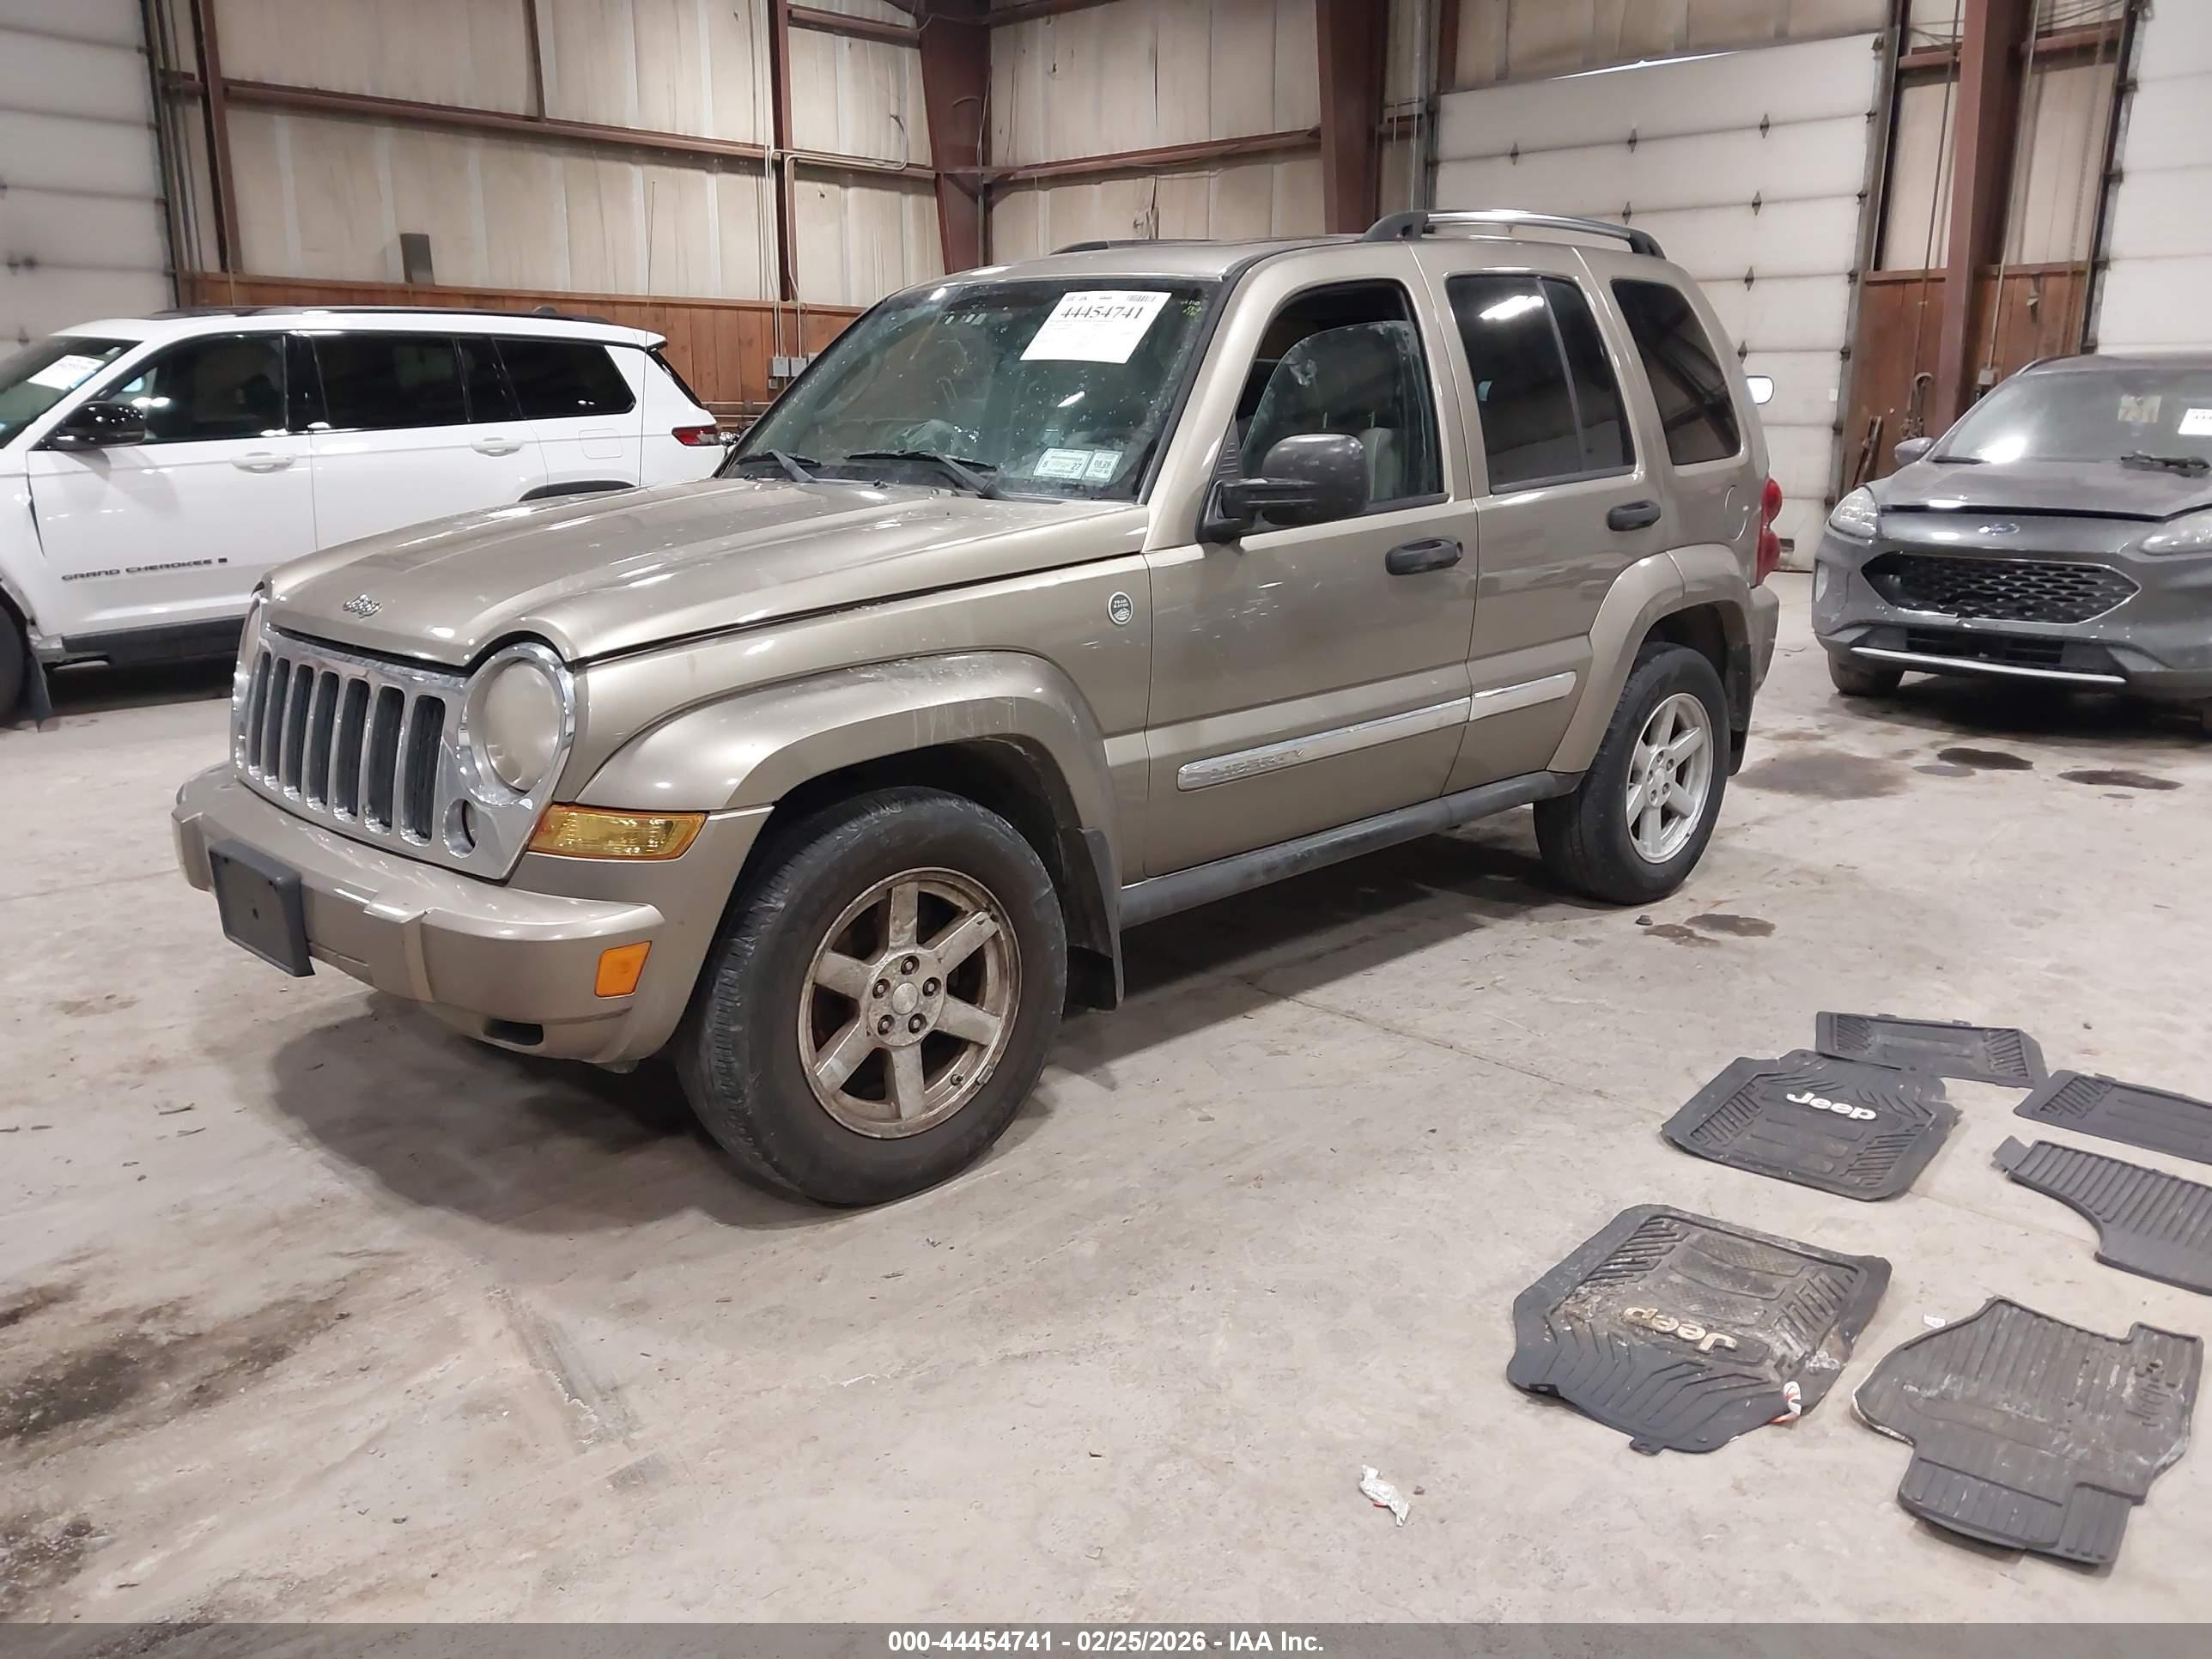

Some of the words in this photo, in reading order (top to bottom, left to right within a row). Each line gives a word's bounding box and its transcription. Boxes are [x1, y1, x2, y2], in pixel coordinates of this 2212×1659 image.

[1060, 305, 1144, 319] 44454741
[61, 568, 120, 580] GRAND
[125, 558, 213, 574] CHEROKEE
[1209, 747, 1306, 779] LIBERTY
[1785, 1091, 1877, 1121] Jeep
[1623, 1306, 1738, 1354] Jeep
